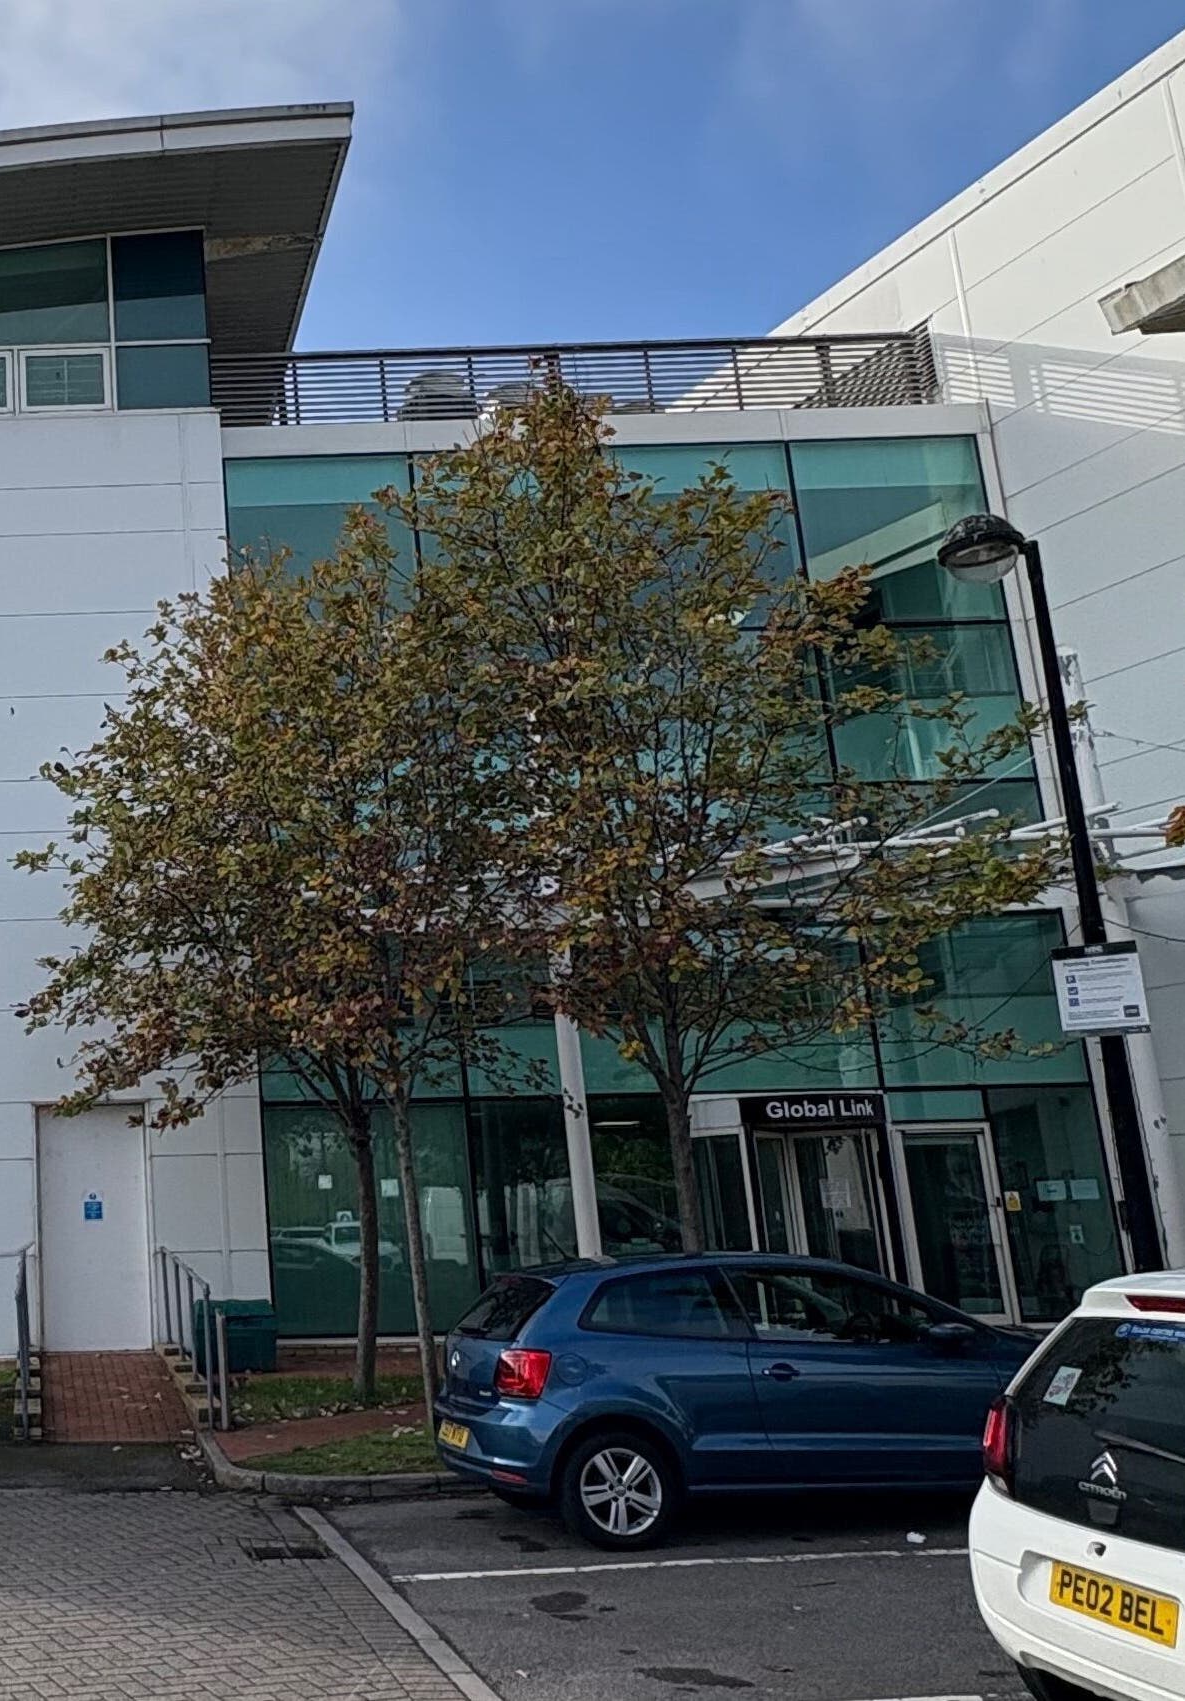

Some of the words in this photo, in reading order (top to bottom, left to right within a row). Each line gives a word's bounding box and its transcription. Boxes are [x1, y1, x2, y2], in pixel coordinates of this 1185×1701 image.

[766, 1099, 835, 1118] Global
[839, 1099, 874, 1116] Link
[1059, 1569, 1114, 1617] PE02
[1118, 1589, 1164, 1636] BEL
